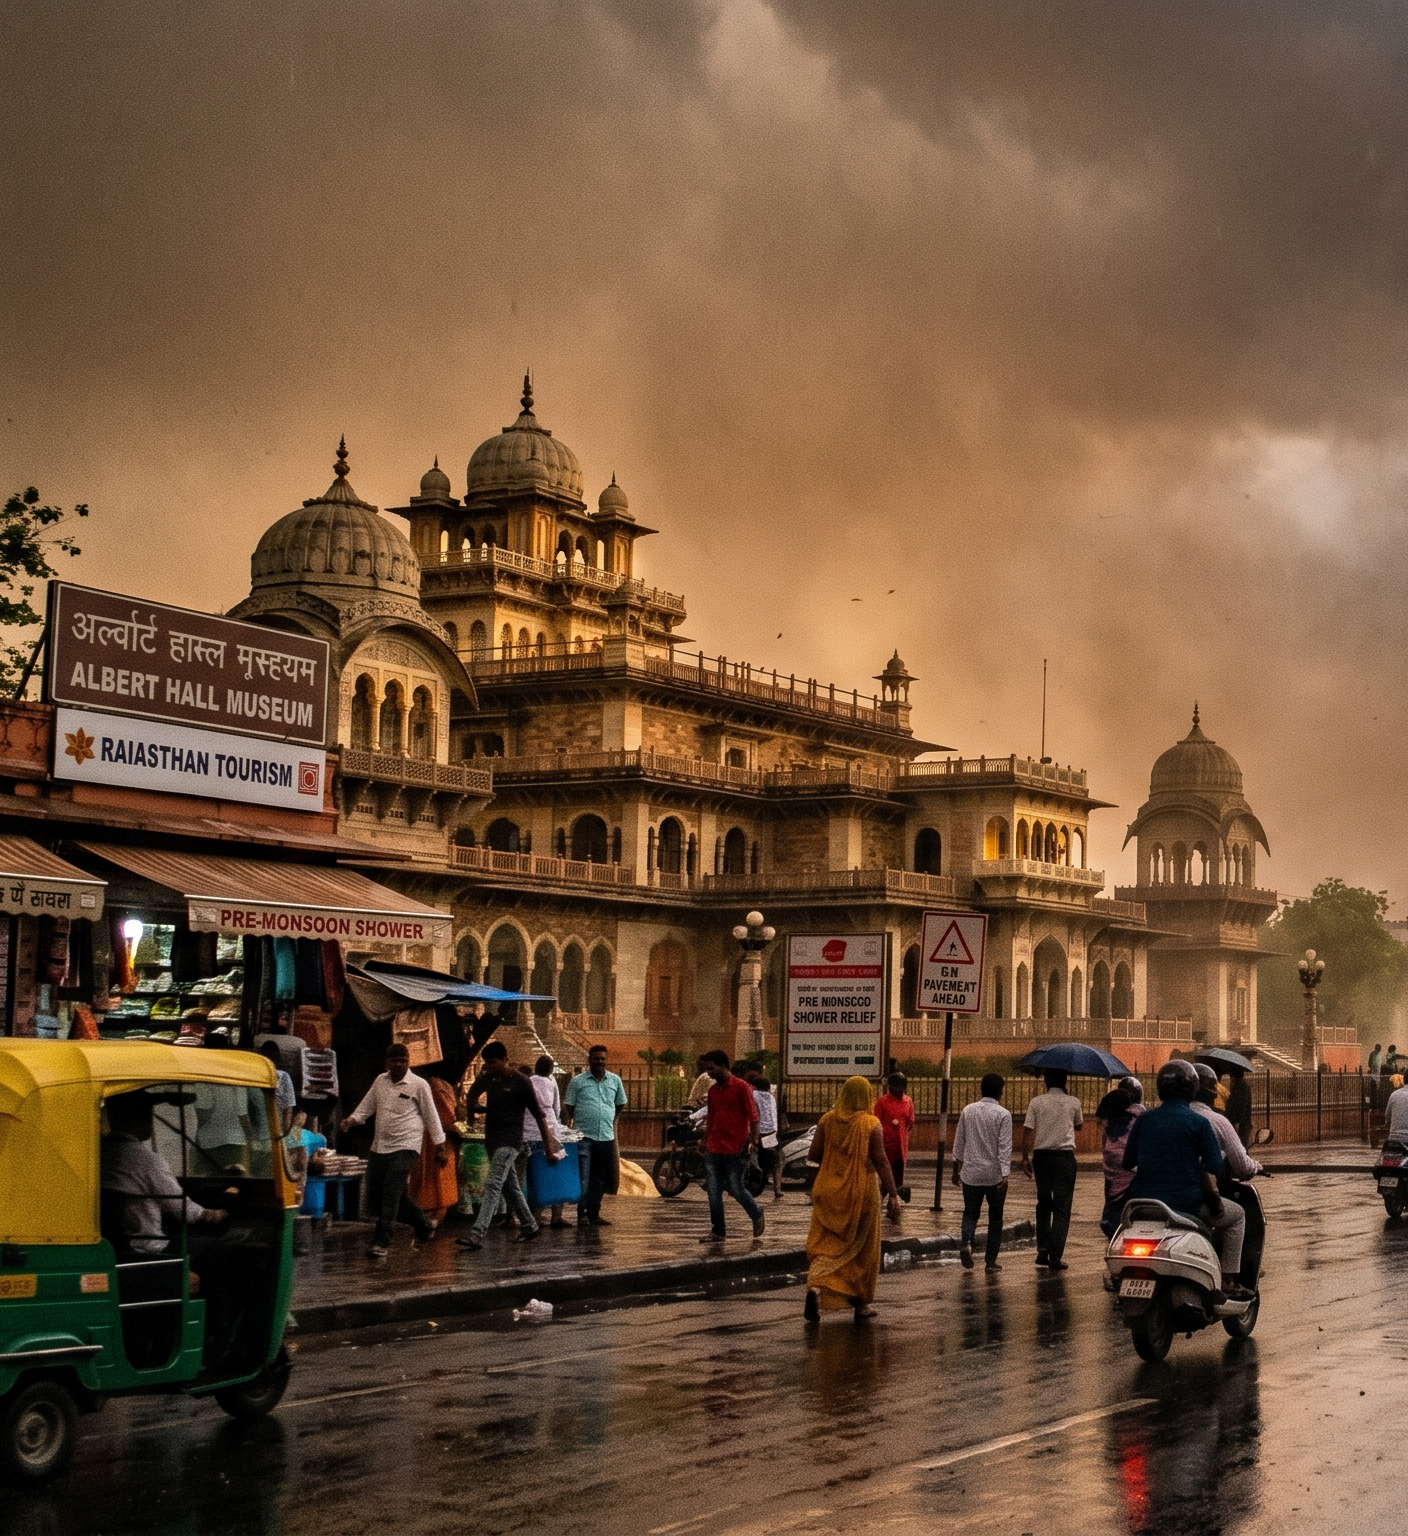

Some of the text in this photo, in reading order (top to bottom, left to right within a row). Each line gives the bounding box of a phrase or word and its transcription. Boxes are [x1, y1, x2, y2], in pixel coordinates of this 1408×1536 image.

[70, 661, 313, 728] ALBERT HALL MUSEUM
[215, 754, 293, 787] TOURISM
[221, 909, 424, 939] PRE-MONSOON SHOWER
[799, 996, 818, 1007] PRE
[931, 992, 966, 1006] AHEAD
[793, 1011, 877, 1024] SHOWER RELIEF
